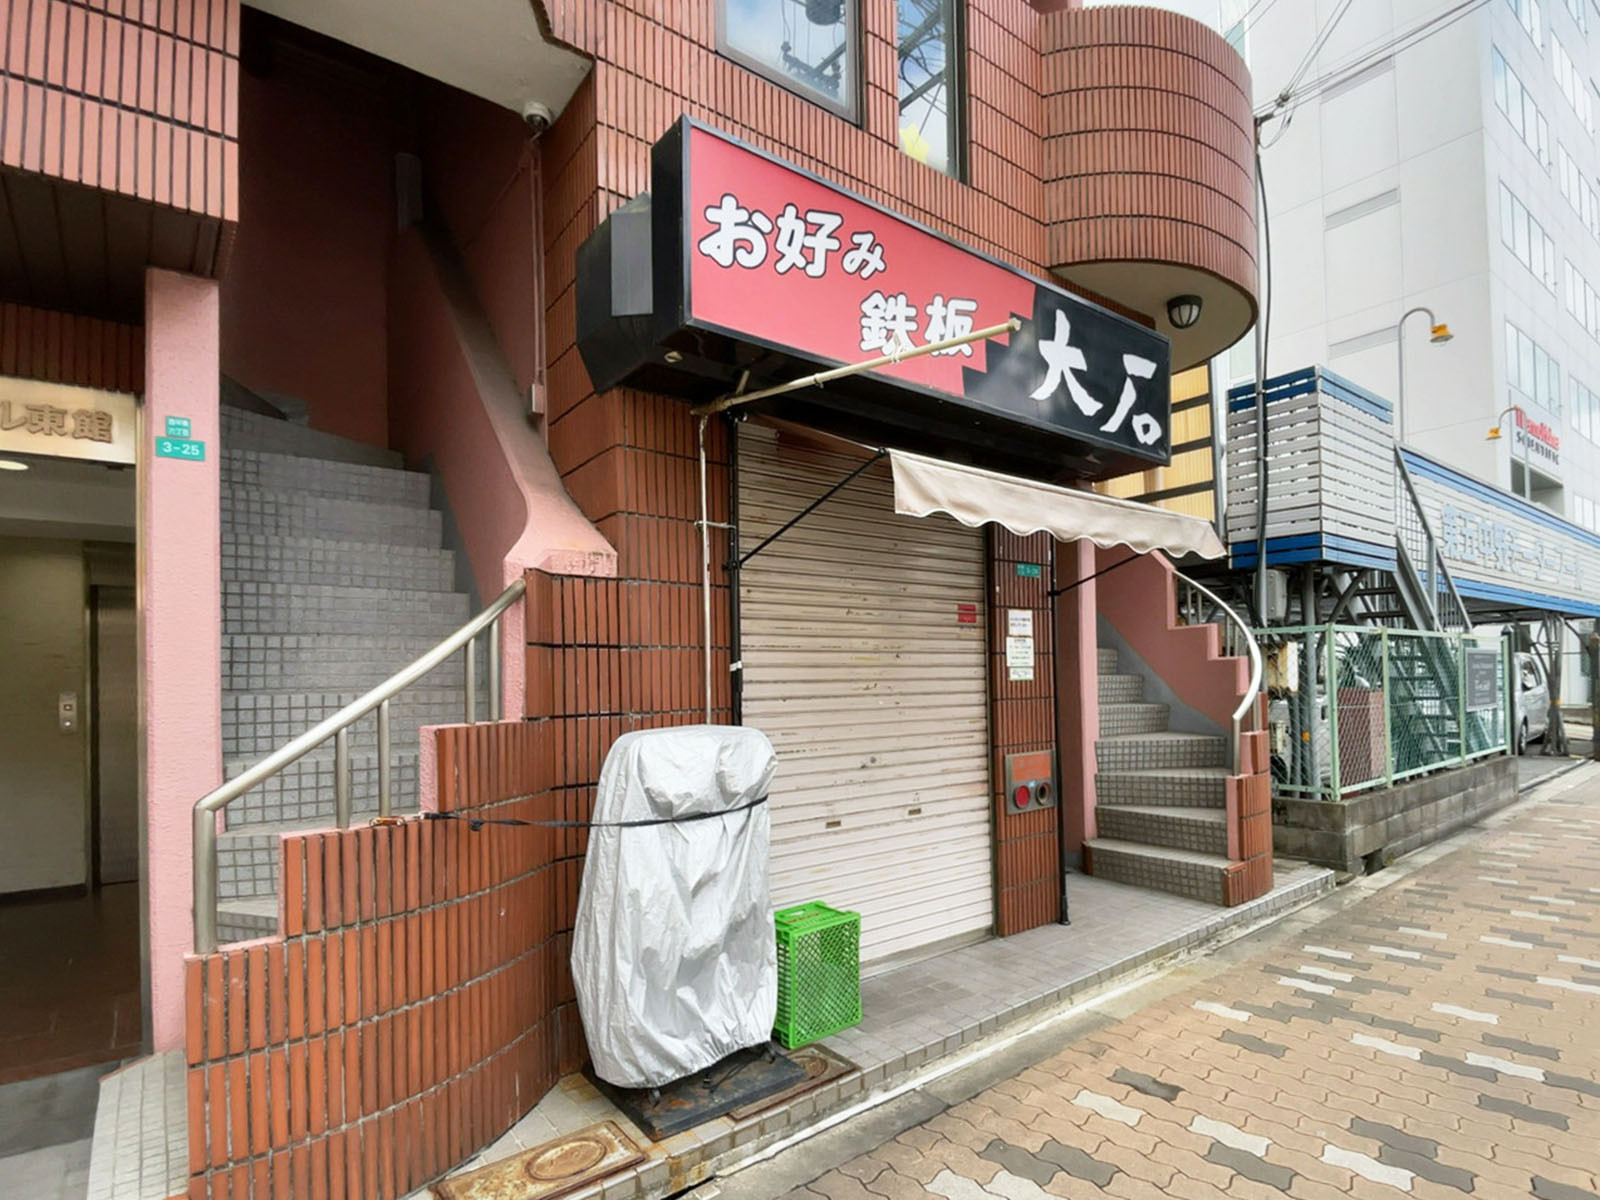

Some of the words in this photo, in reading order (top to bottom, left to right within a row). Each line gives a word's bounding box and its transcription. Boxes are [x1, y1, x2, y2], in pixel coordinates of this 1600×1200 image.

[698, 193, 887, 279] お好み
[859, 290, 977, 358] 鉄板
[1028, 308, 1161, 446] 大石
[162, 441, 200, 456] 3-25
